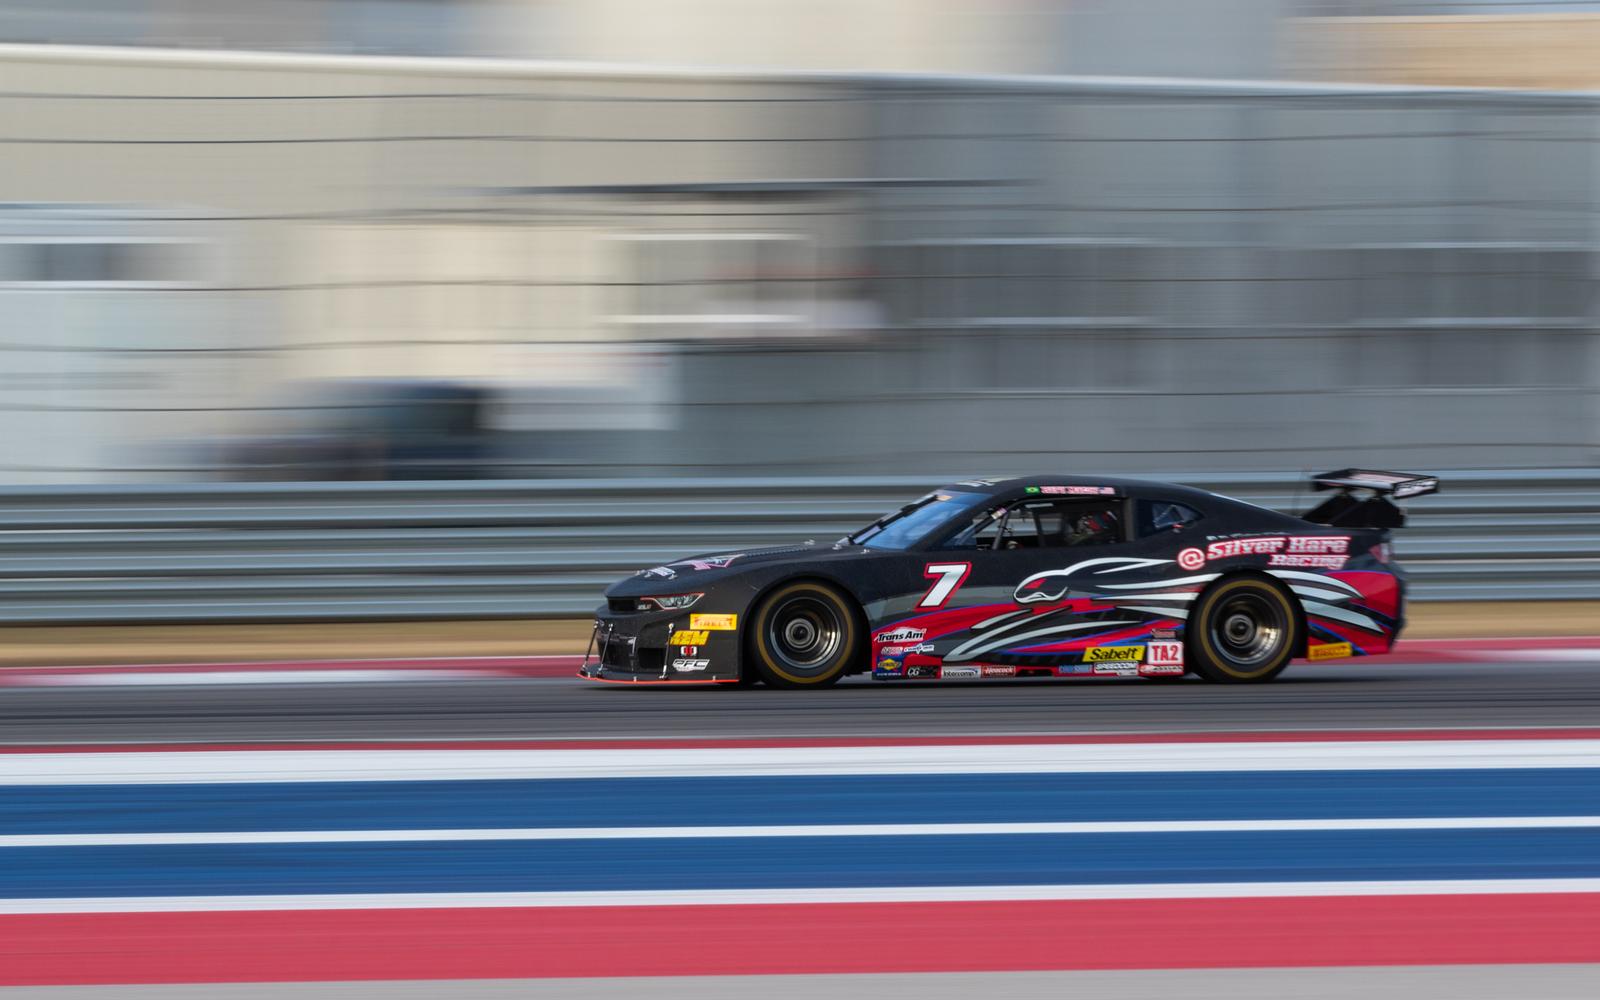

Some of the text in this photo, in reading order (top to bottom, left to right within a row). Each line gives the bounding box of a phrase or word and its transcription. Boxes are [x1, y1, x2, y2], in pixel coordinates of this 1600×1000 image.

[1206, 537, 1287, 560] Silver
[1287, 536, 1351, 554] Hare
[1268, 554, 1350, 571] Racing
[916, 562, 971, 609] 7
[877, 629, 924, 643] Trans Am
[1089, 647, 1139, 661] Sabelt
[1150, 644, 1179, 662] TA2
